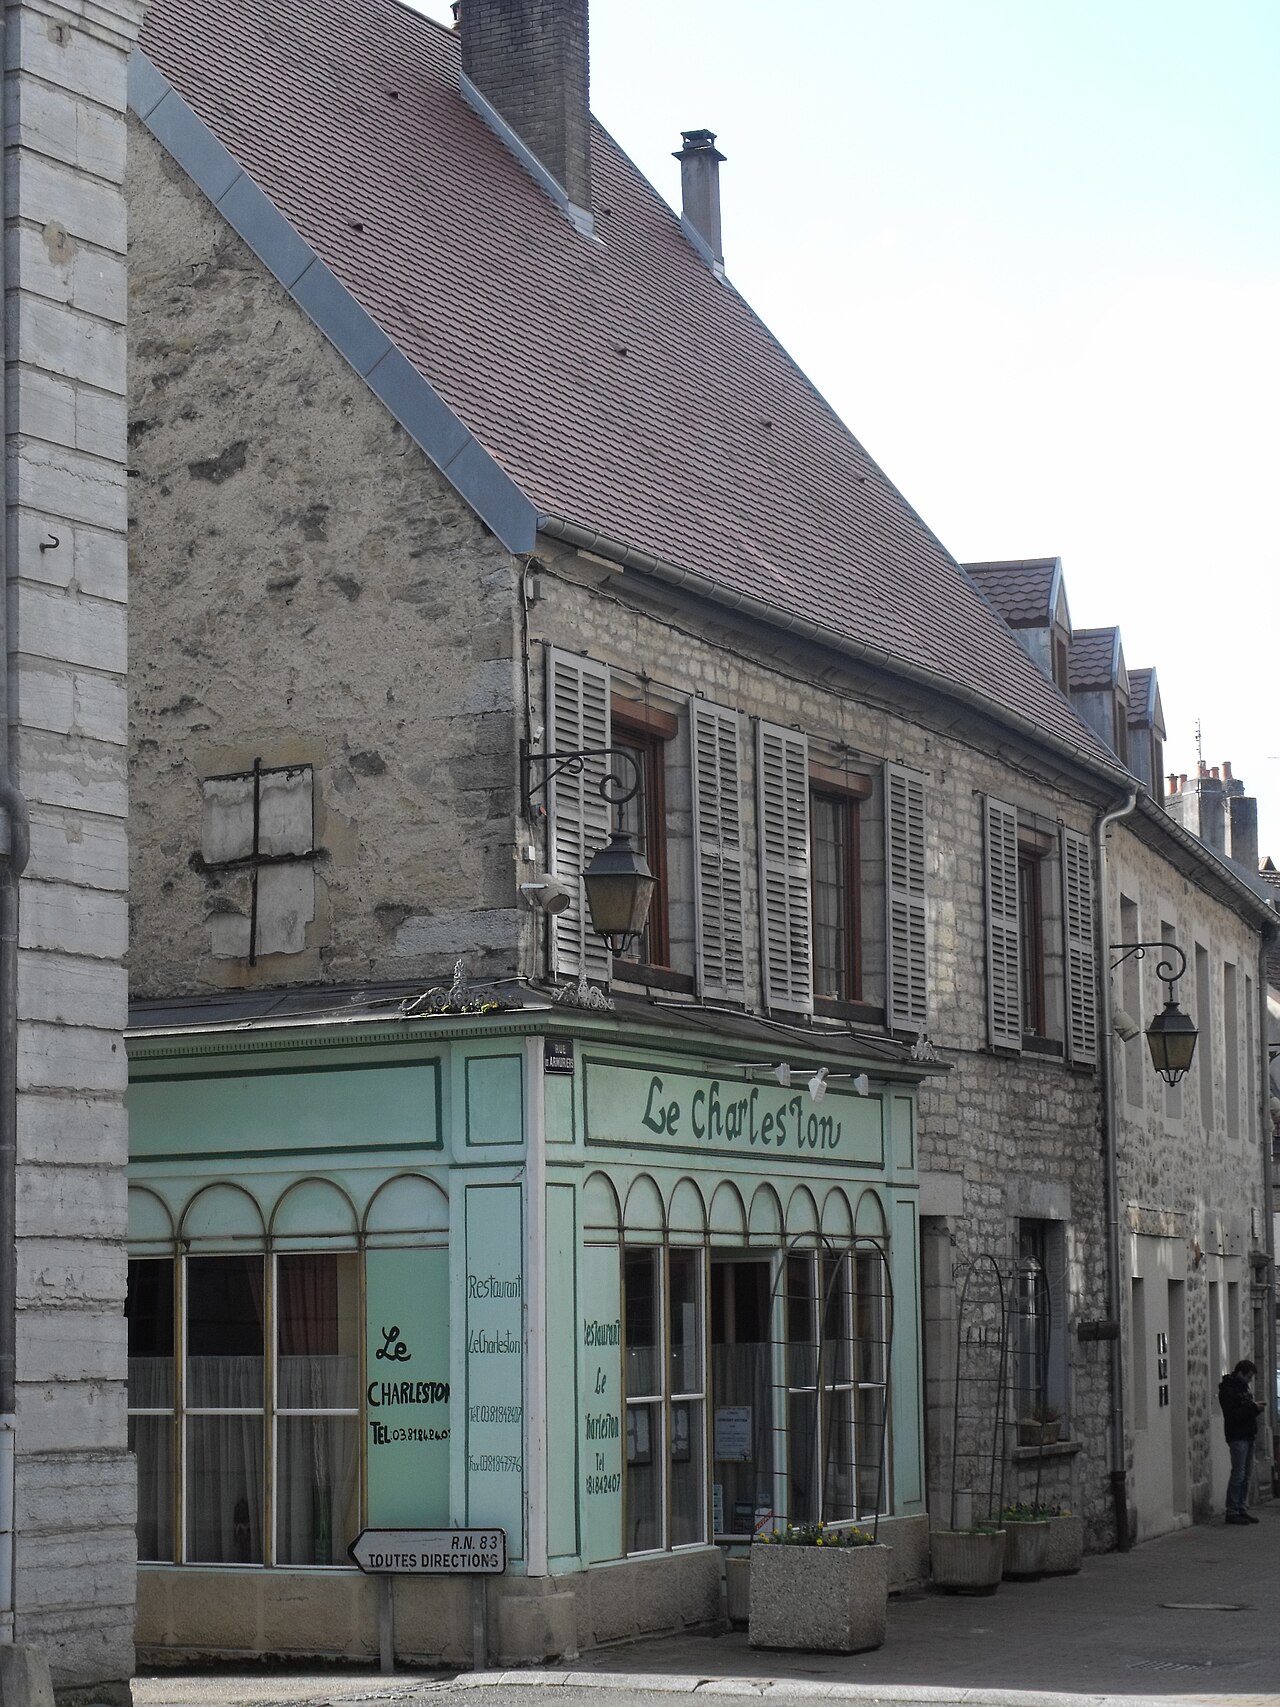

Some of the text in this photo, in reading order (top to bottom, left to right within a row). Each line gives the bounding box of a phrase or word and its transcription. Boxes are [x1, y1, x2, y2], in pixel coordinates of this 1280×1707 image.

[642, 1076, 841, 1150] Le Charleston
[468, 1275, 522, 1299] Restaurant
[376, 1326, 412, 1362] Le
[594, 1366, 607, 1395] Le
[595, 1452, 605, 1472] Tel
[451, 1535, 498, 1550] R.N. 83
[368, 1553, 499, 1568] TOUTES DIRECTIONS
